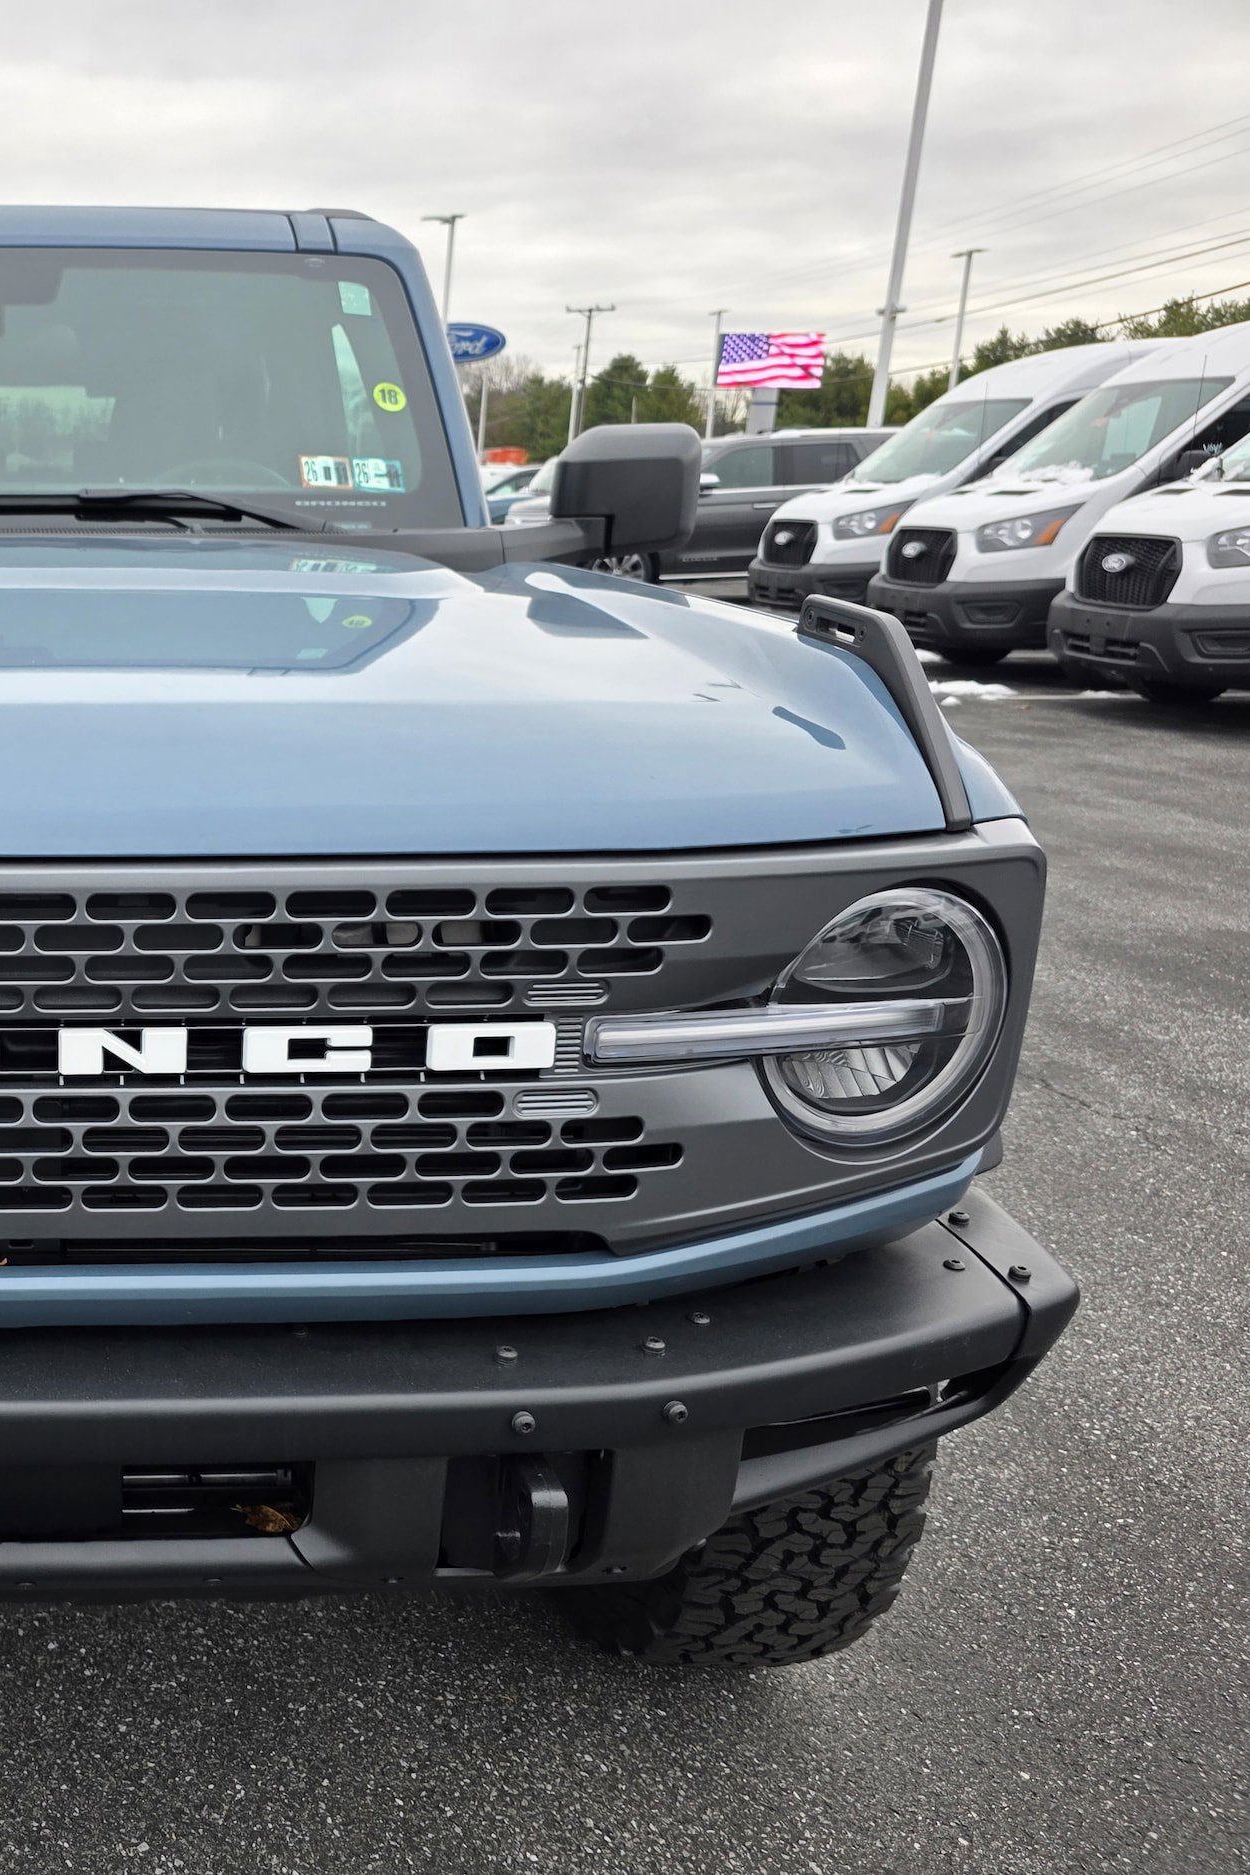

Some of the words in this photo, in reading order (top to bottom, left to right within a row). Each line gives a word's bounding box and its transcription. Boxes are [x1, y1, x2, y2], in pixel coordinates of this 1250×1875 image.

[379, 388, 399, 405] 18
[304, 460, 319, 482] 26
[356, 462, 370, 484] 26
